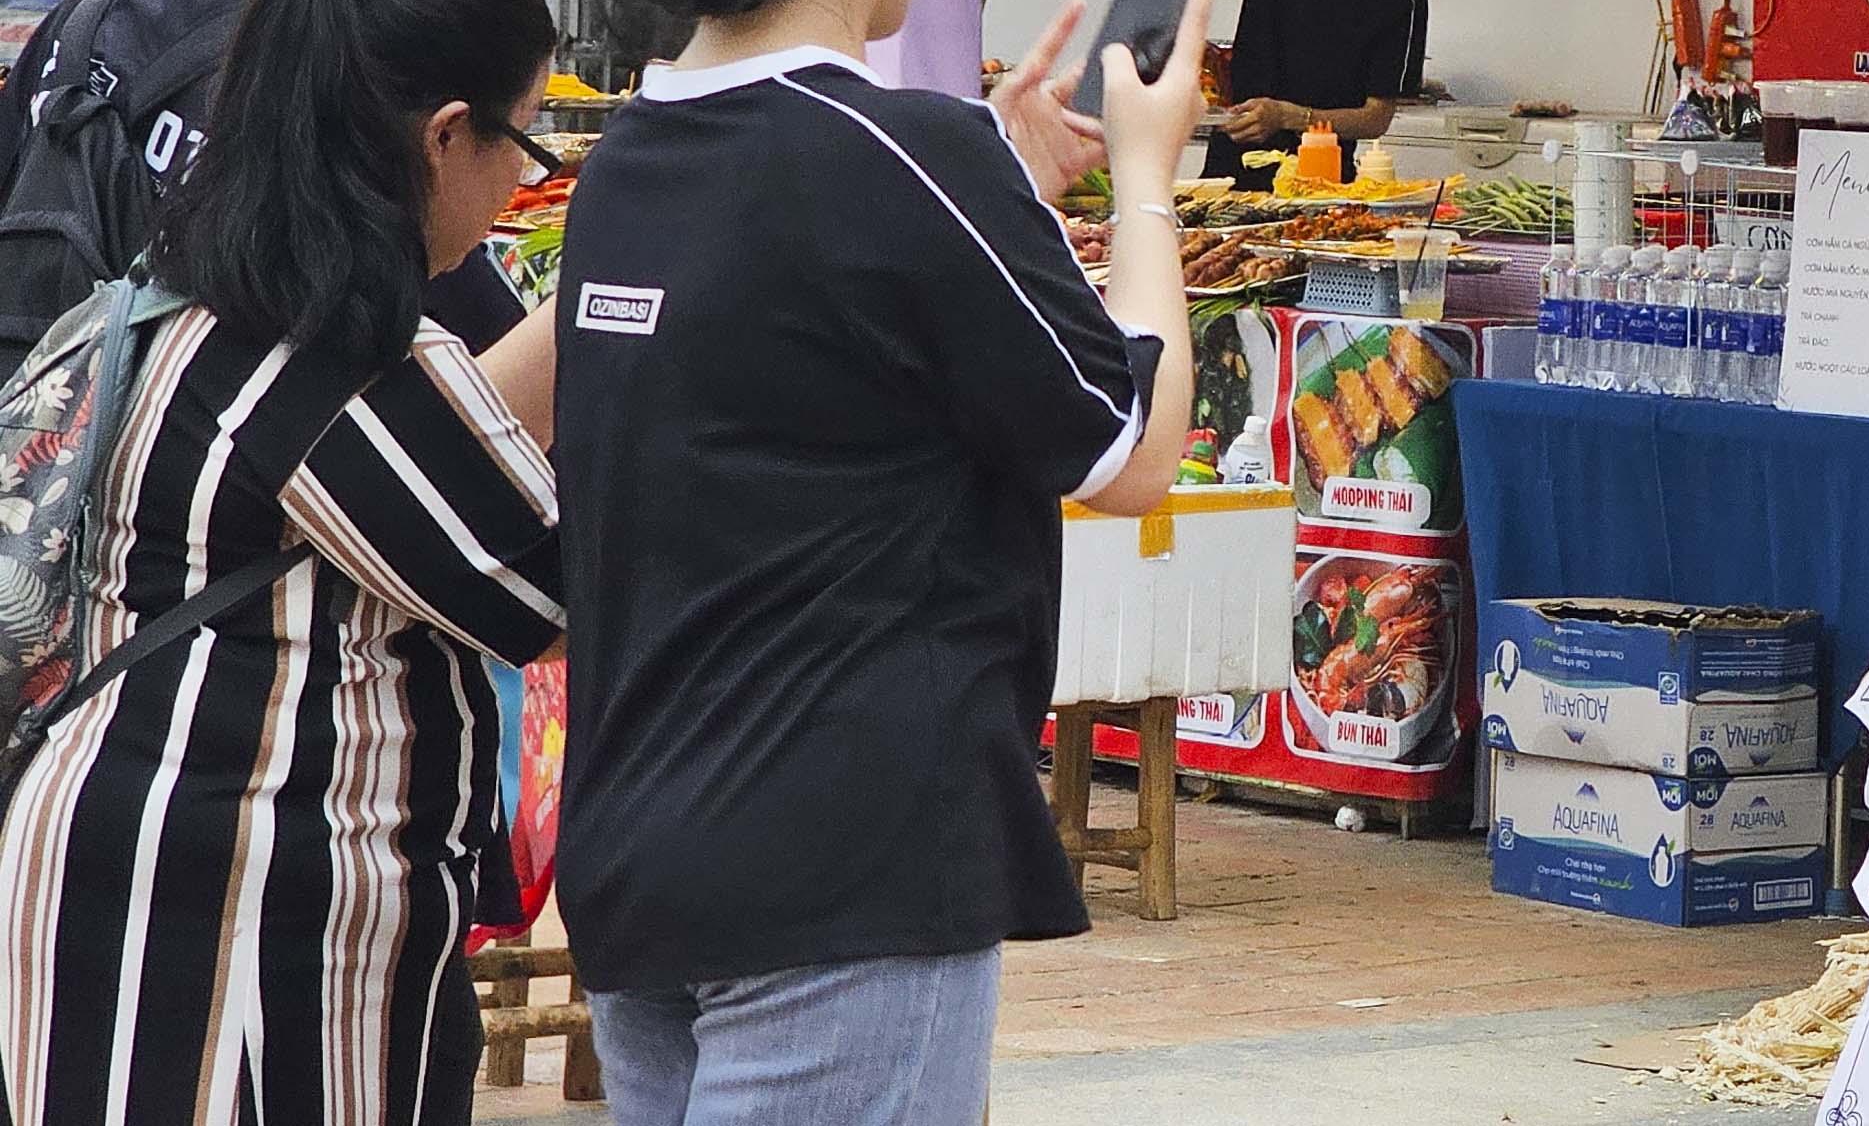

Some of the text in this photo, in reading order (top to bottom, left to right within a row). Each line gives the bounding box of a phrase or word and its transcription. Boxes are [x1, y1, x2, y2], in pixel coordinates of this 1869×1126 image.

[589, 297, 650, 321] OZINBASI
[1331, 487, 1414, 513] MOOPING THÁI
[1199, 700, 1224, 723] THÁI
[1541, 684, 1609, 724] AQUAFINA
[1336, 719, 1388, 748] BÚN THÁI
[1725, 720, 1797, 750] AQUAFINA
[1553, 803, 1623, 843] AQUAFINA
[1730, 810, 1787, 831] AQUAFINA
